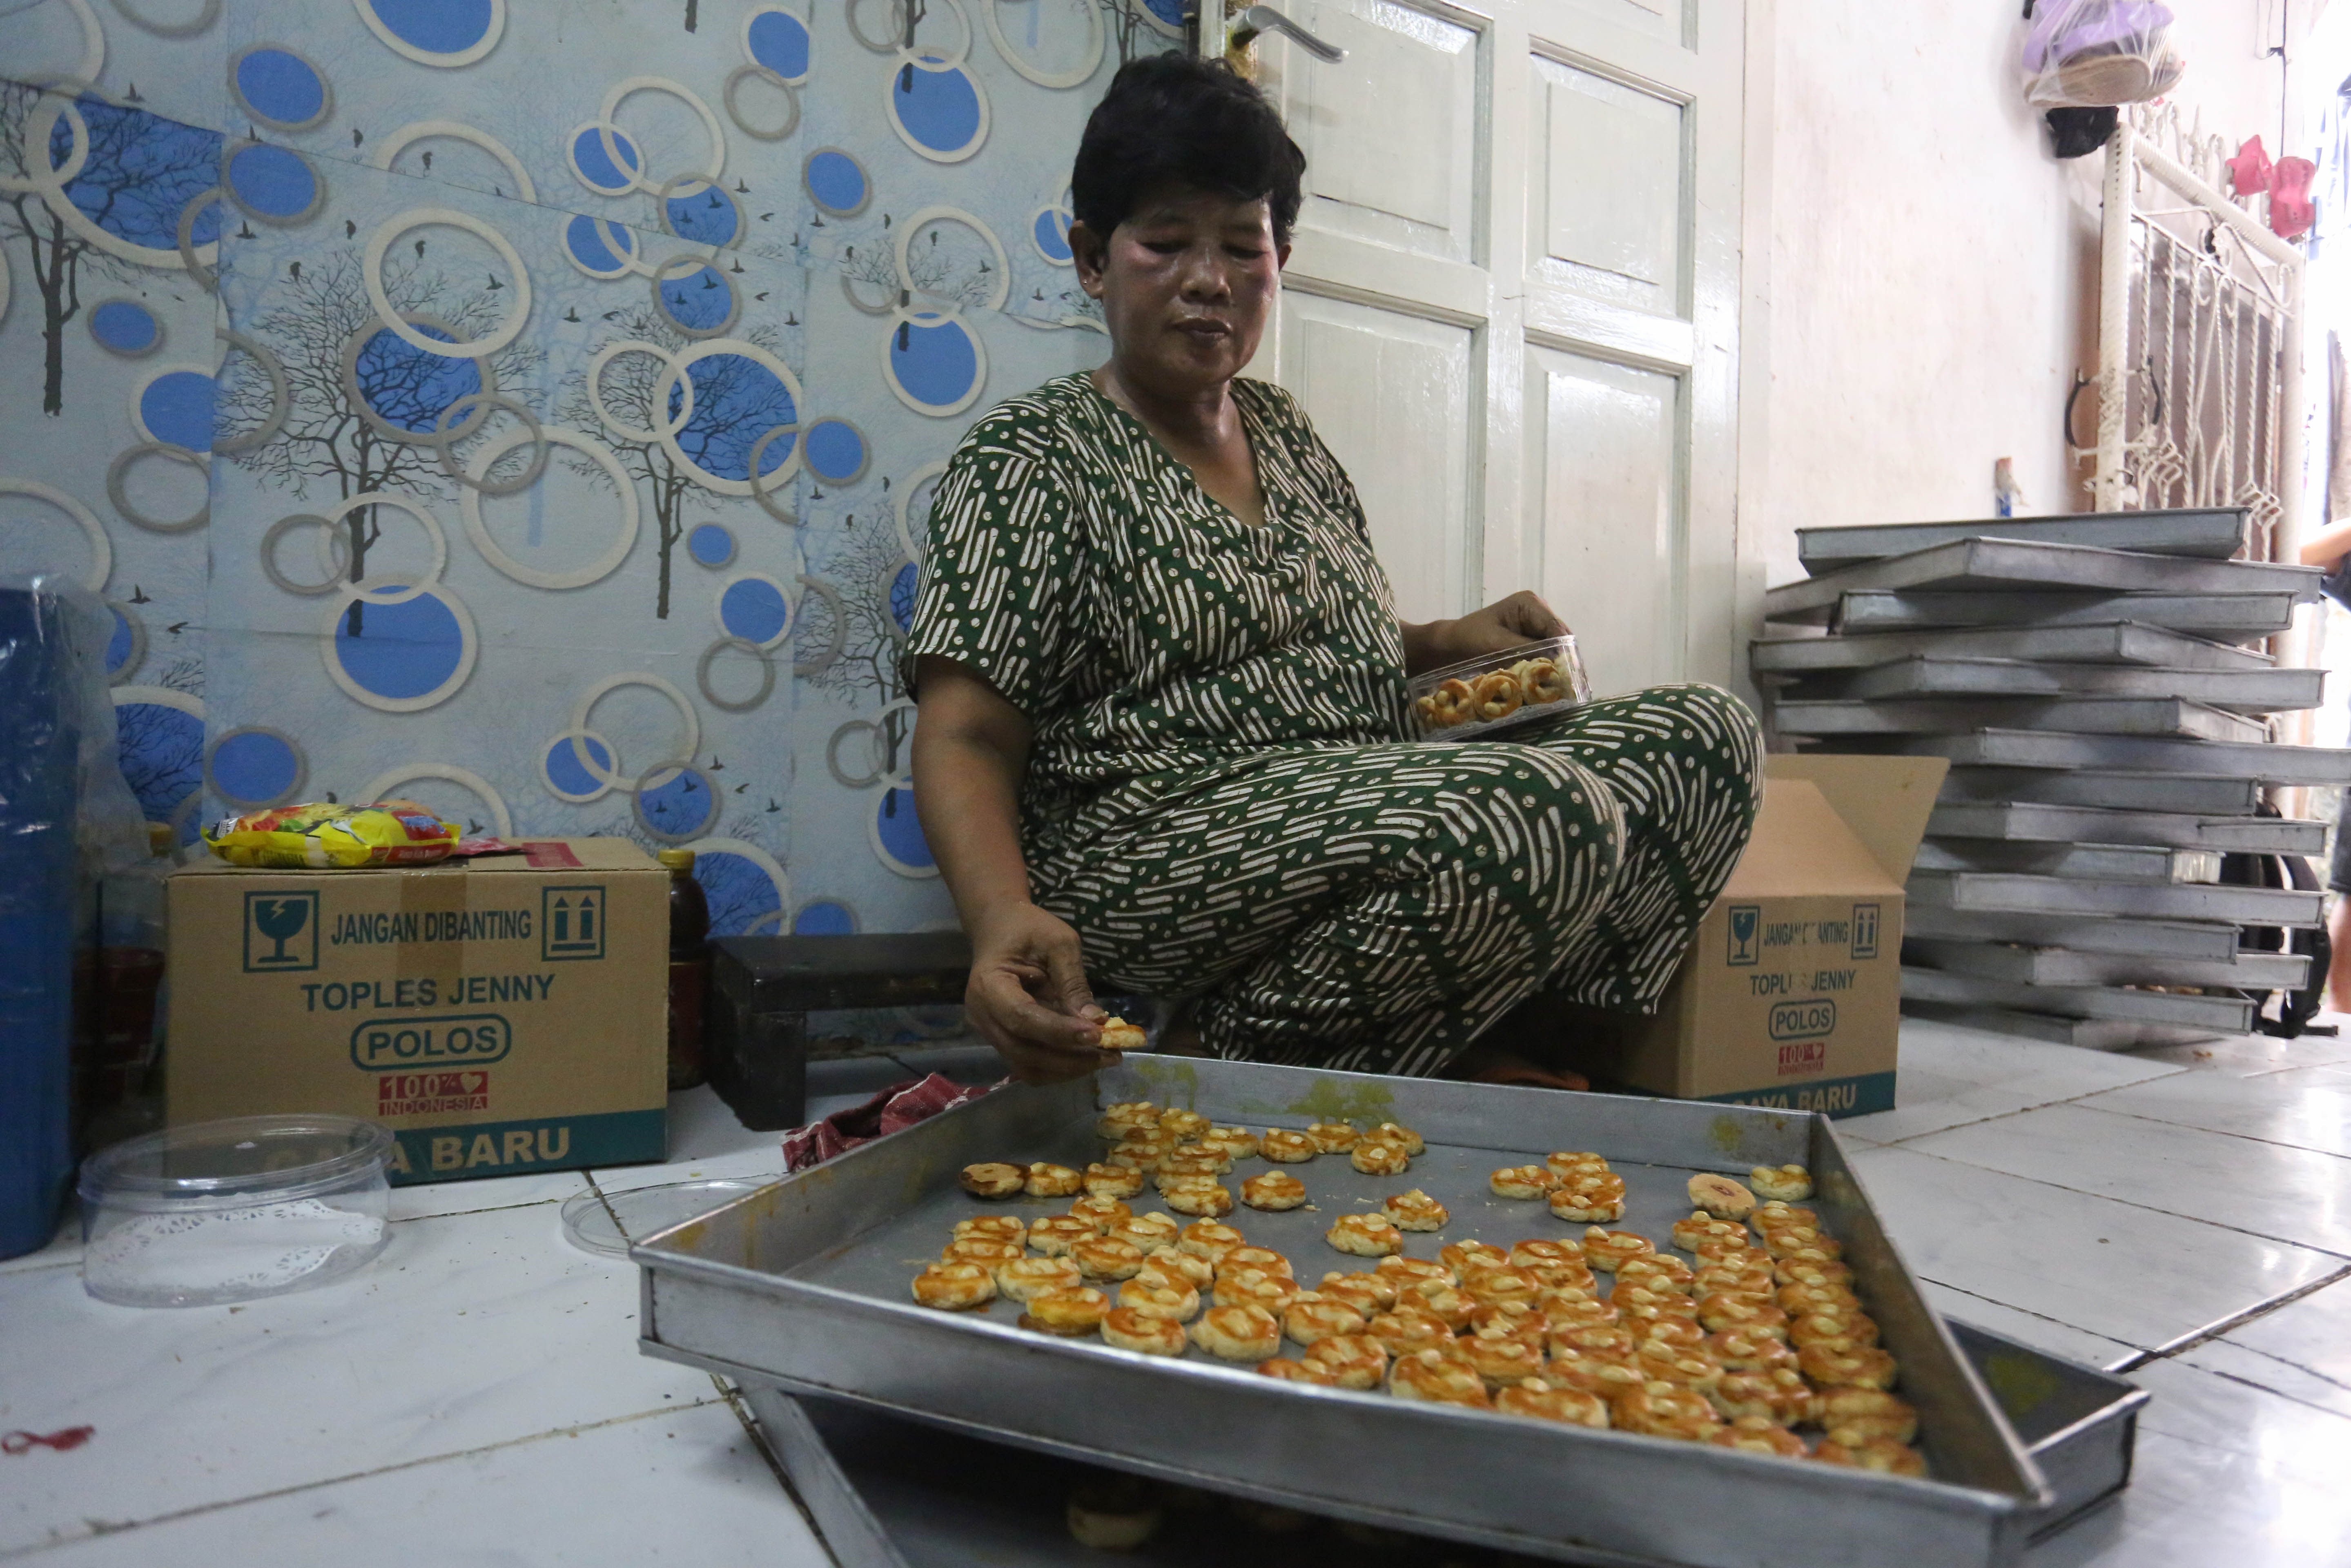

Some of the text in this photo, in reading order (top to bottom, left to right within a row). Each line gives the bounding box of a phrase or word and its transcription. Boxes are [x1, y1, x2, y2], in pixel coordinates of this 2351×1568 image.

[331, 910, 531, 945] JANGAN DIBANTING
[301, 973, 555, 1011] TOPLES JENNY
[1750, 969, 1856, 995] TOPL JENNY
[1776, 1007, 1830, 1032] POLOS
[368, 1025, 497, 1060] POLOS
[386, 1074, 456, 1100] 100%
[1798, 1084, 1856, 1113] BARU
[383, 1096, 485, 1116] INDONESIA
[431, 1127, 569, 1171] BARU
